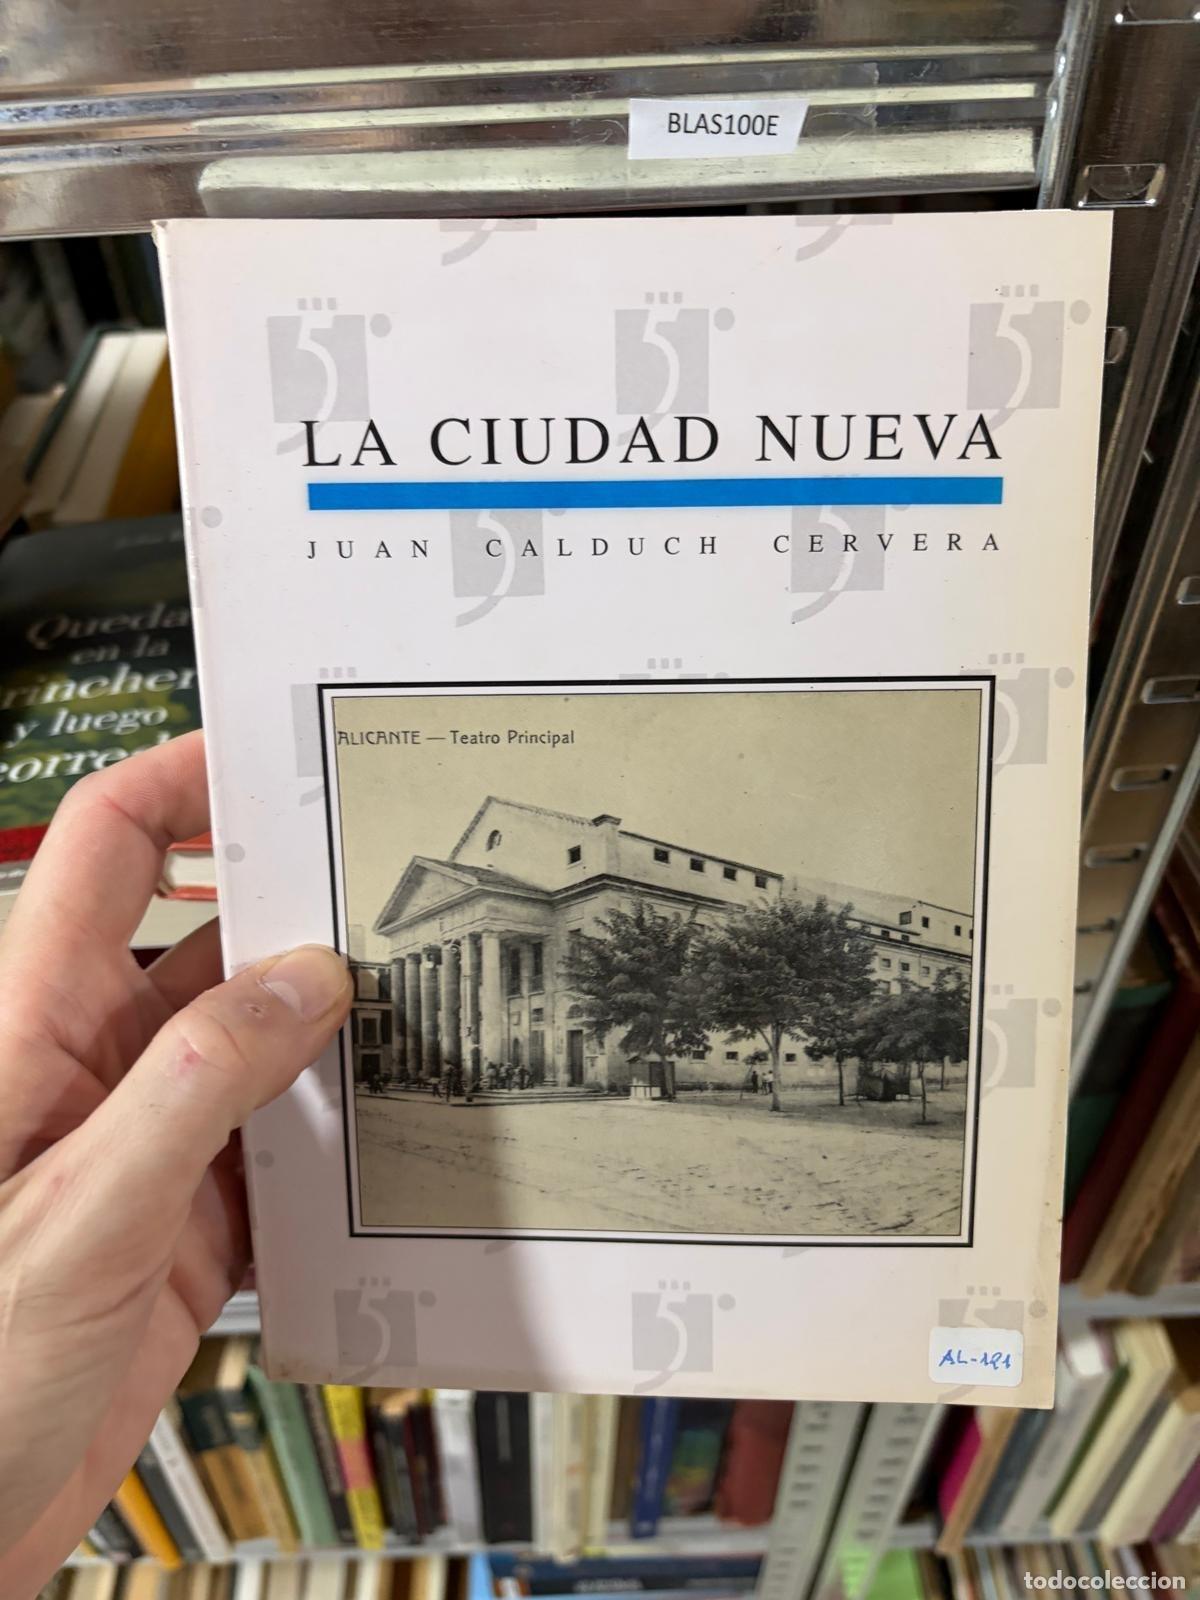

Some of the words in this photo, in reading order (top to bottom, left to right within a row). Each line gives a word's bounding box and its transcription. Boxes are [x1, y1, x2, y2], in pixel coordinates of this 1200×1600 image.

[667, 112, 780, 136] BLAS100E
[300, 418, 398, 467] LA
[430, 415, 719, 466] CIUDAD
[755, 412, 1003, 462] NUEVA
[307, 539, 429, 560] JUAN
[485, 536, 718, 558] CALDUCH
[773, 532, 1000, 554] CERVERA
[70, 642, 121, 667] en
[131, 634, 171, 660] la
[0, 662, 198, 710] rincher
[5, 720, 41, 749] y
[48, 706, 168, 737] luego
[337, 730, 421, 746] ALICANTE
[450, 729, 501, 745] Teatro
[507, 729, 575, 748] Principal
